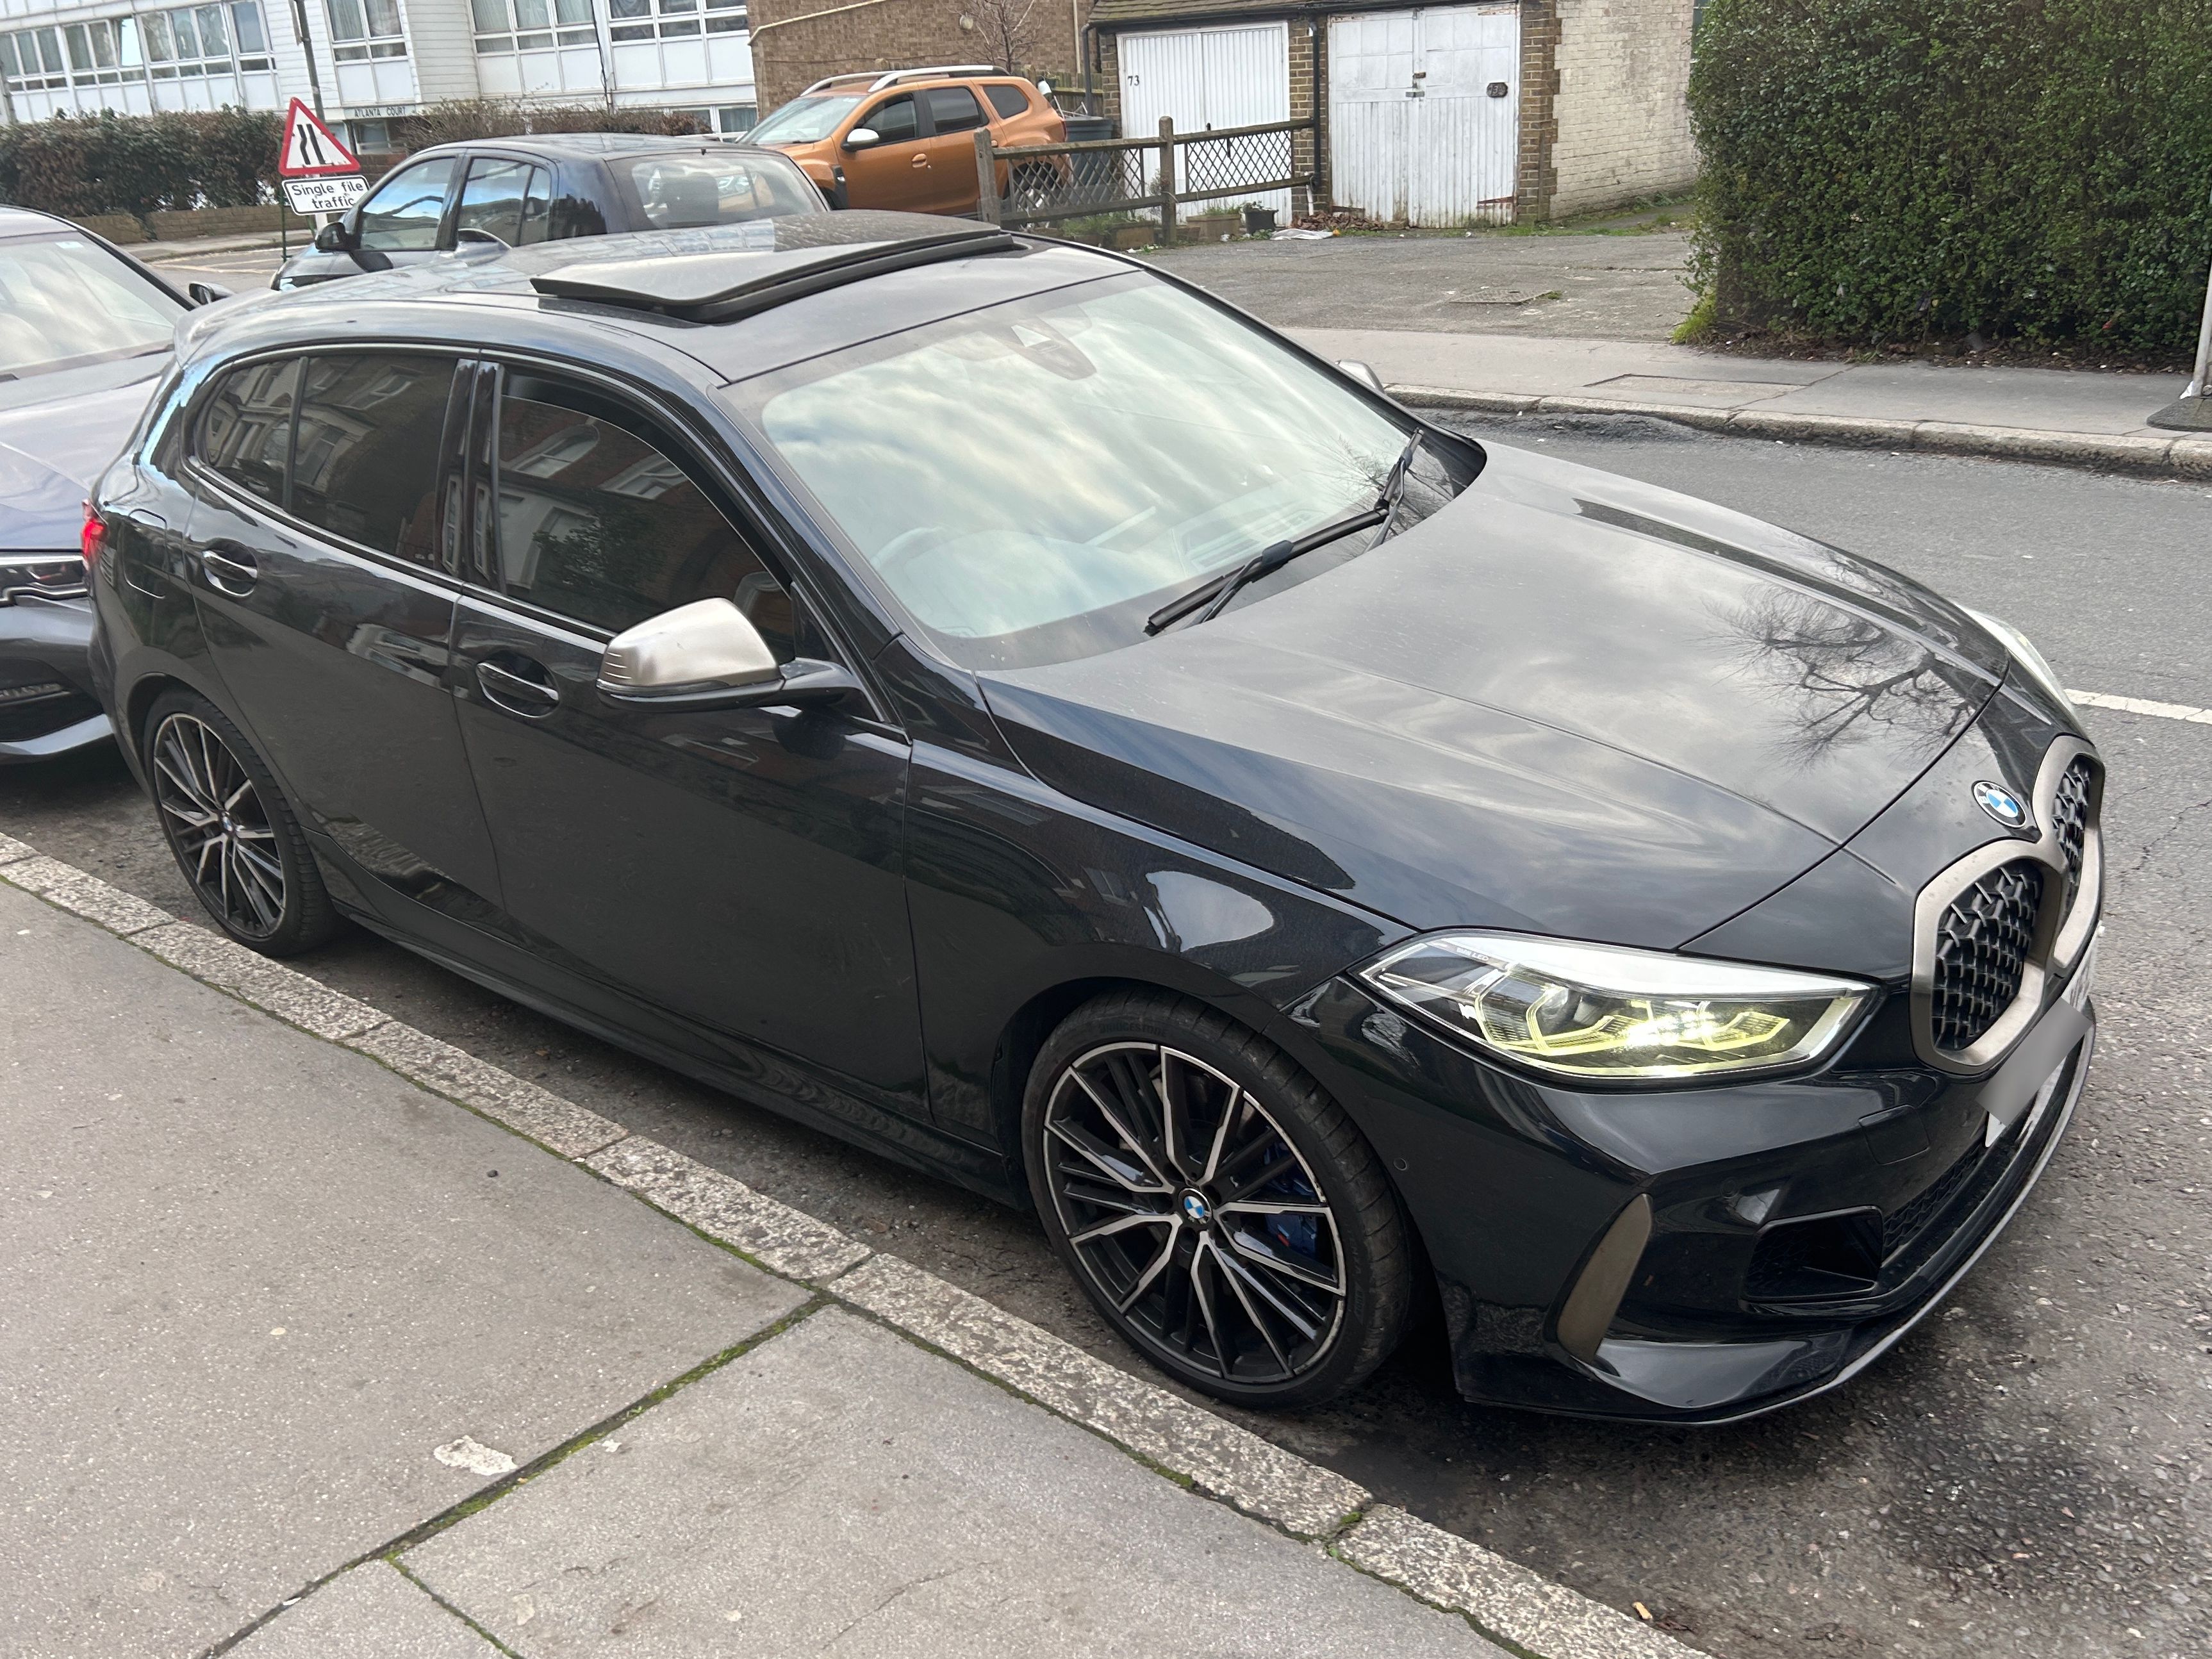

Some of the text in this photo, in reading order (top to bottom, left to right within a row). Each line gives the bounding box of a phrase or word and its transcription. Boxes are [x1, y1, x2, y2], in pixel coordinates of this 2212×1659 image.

[1128, 75, 1139, 87] 73
[354, 106, 406, 117] ATLANTA COURT
[291, 181, 364, 196] Single file
[311, 195, 354, 209] traffic
